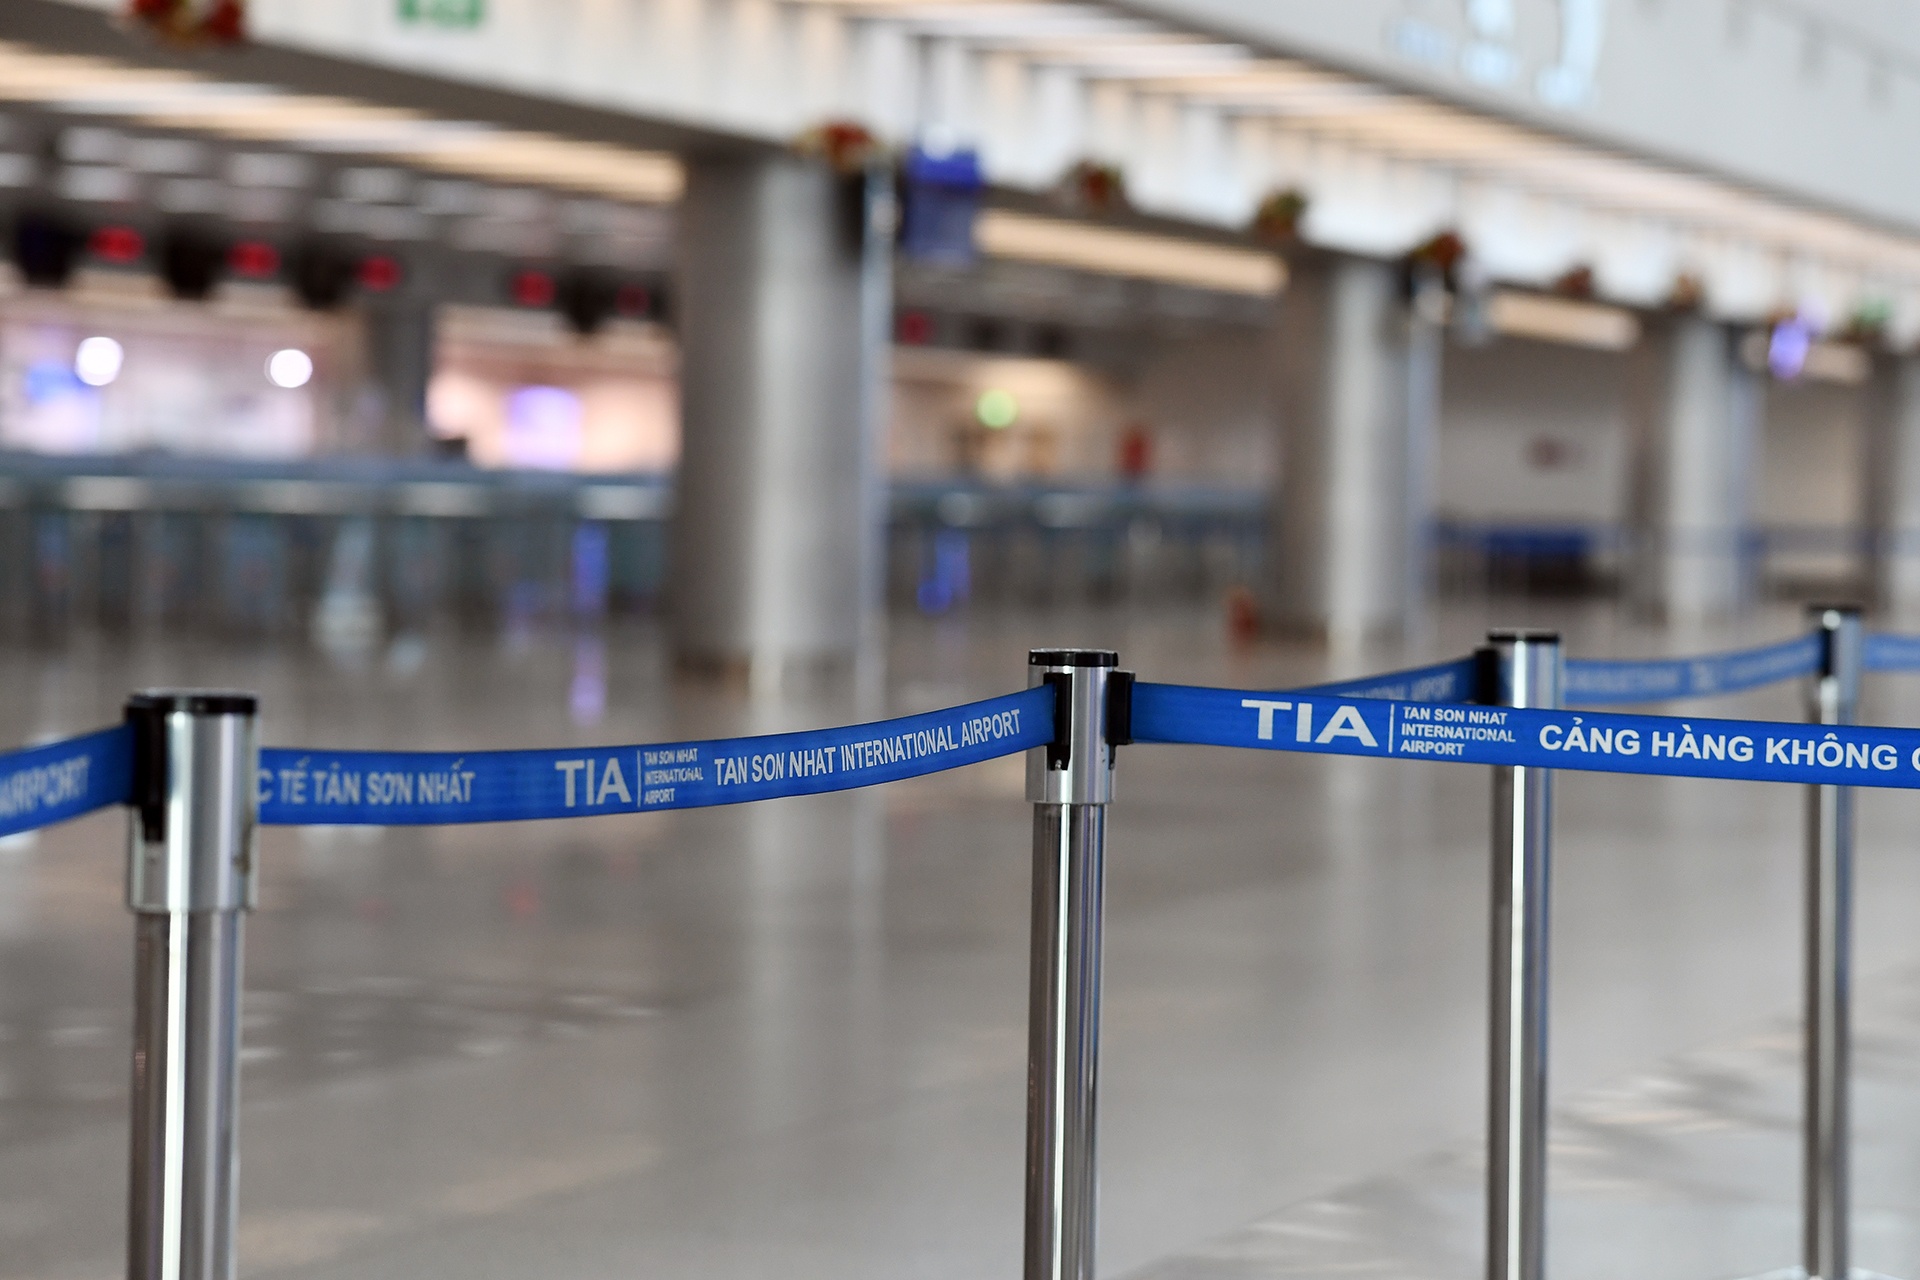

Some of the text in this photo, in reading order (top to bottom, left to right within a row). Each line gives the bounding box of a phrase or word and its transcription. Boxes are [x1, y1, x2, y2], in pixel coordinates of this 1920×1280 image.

[1241, 699, 1378, 747] TIA
[1403, 706, 1508, 725] TAN SON NHAT
[1401, 723, 1517, 743] INTERNATIONAL
[714, 708, 1020, 786] TAN SON NHAT INTERNATIONAL AIRPORT
[1400, 740, 1465, 756] AIRPORT
[1539, 717, 1640, 755] CẢNG
[1651, 724, 1754, 762] HÀNG
[1765, 732, 1898, 771] KHÔNG
[659, 750, 675, 765] SON
[676, 748, 698, 763] NHAT
[279, 756, 310, 804] TẾ
[313, 762, 361, 805] TÂN
[366, 771, 414, 805] SƠN
[418, 757, 476, 804] NHẤT
[555, 757, 632, 807] TIA
[644, 767, 704, 785] INTERNATIONAL
[644, 787, 675, 804] AIRPORT
